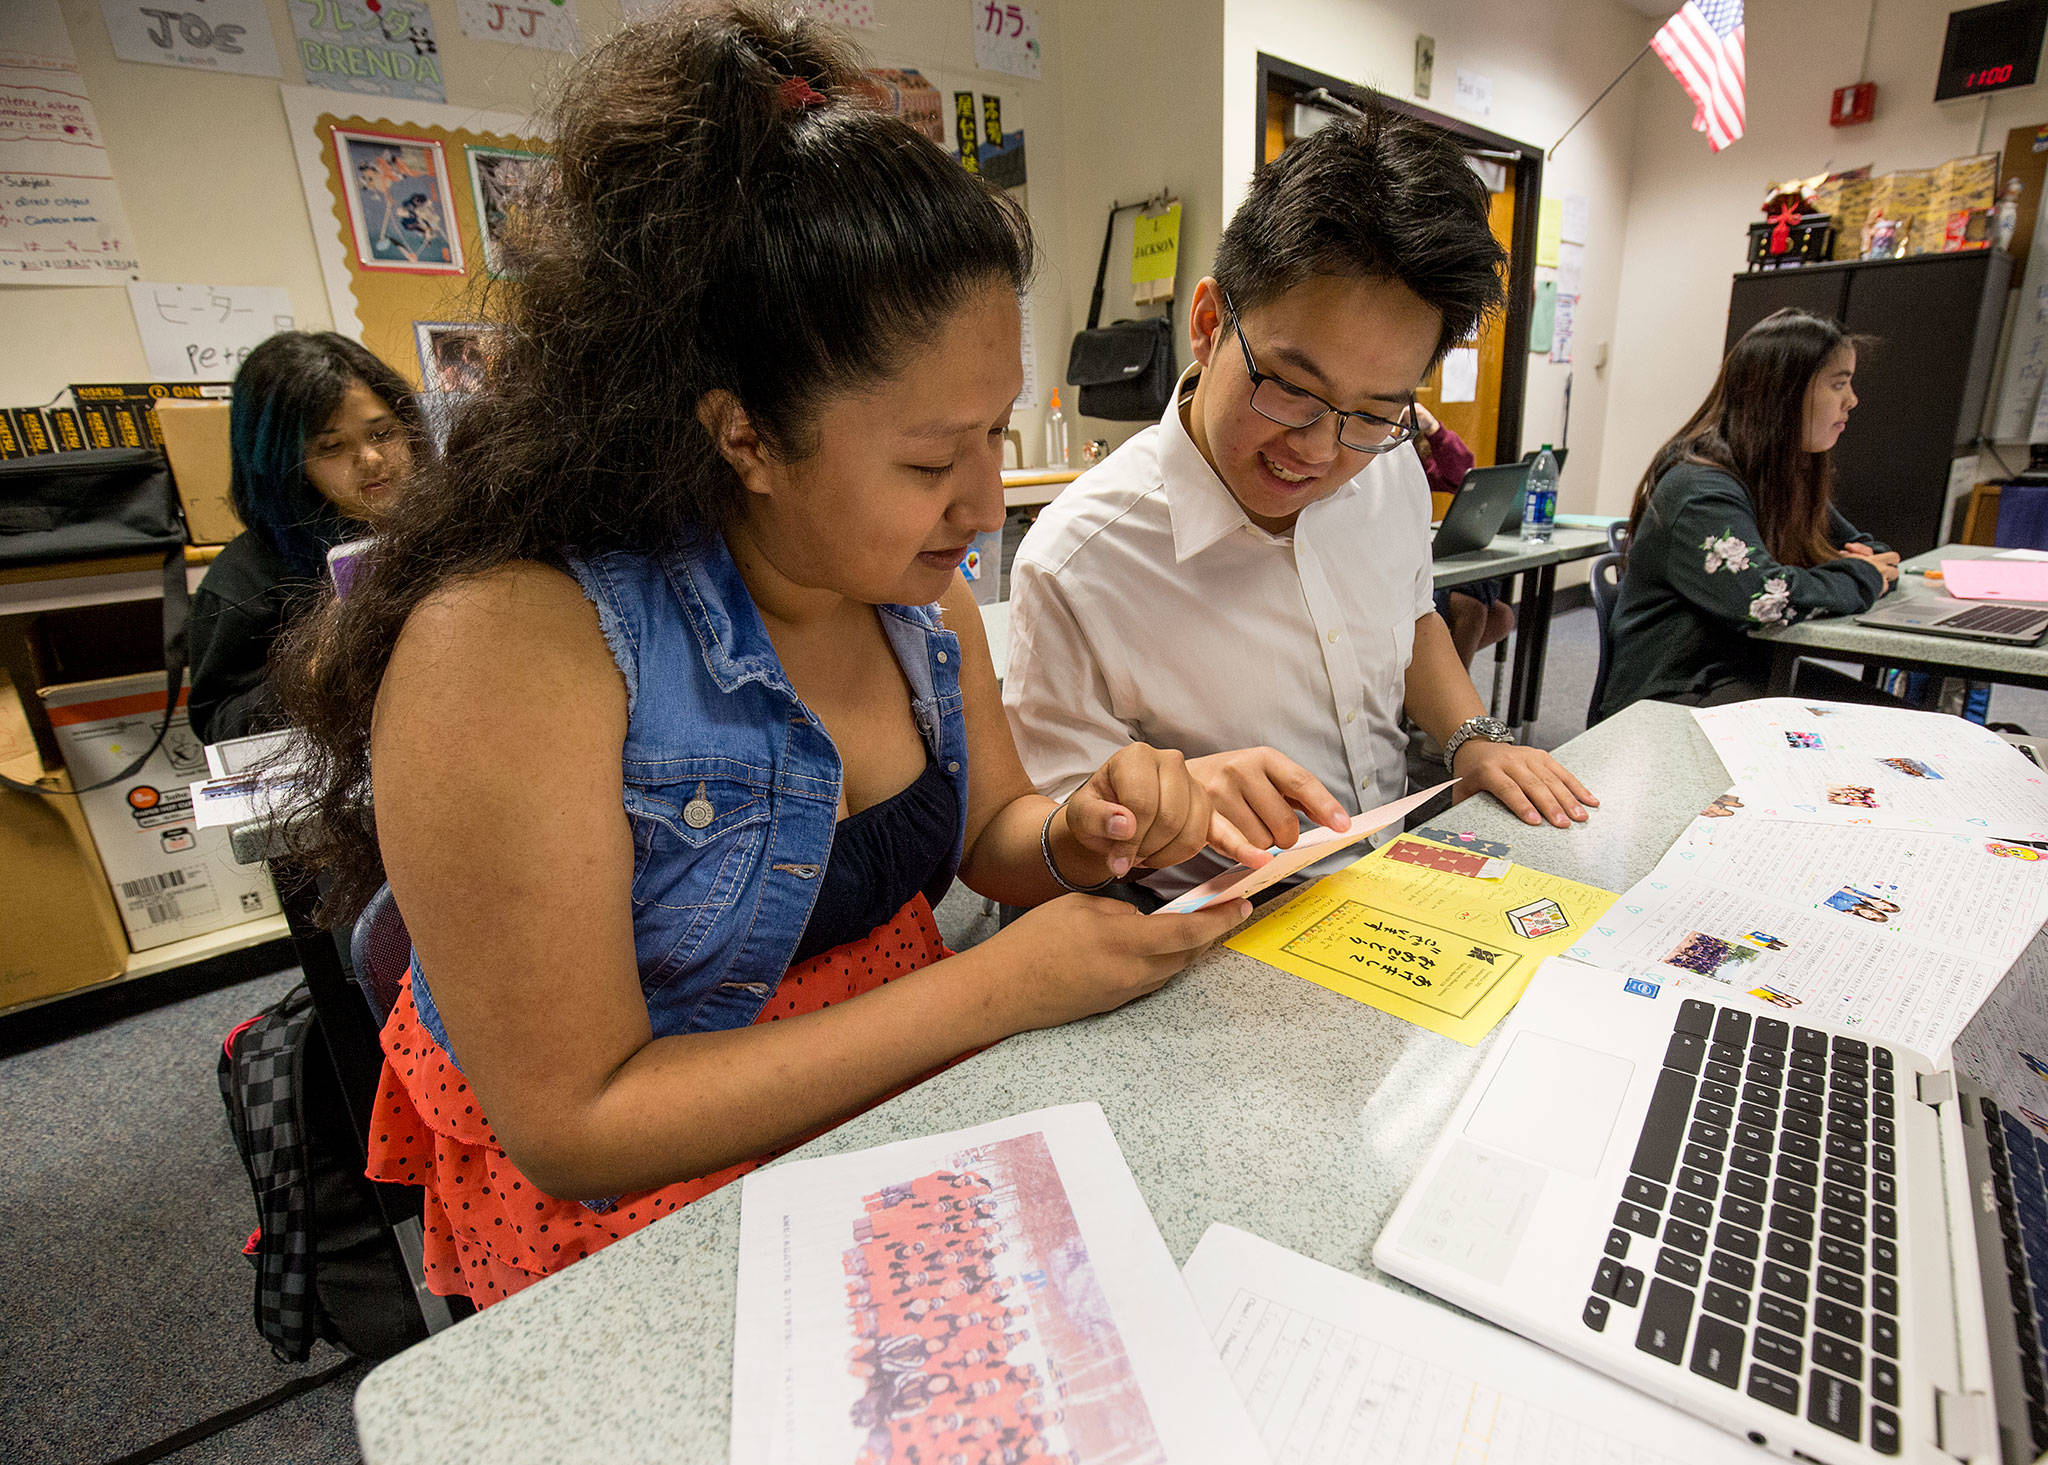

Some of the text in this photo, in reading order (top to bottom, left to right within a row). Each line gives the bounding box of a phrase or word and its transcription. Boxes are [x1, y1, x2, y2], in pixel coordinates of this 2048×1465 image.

[139, 7, 247, 54] JOE
[984, 1, 1023, 38] カラ
[302, 40, 441, 83] BRENDA
[1134, 236, 1175, 258] JACKSON
[1349, 936, 1437, 971] おめでとう
[1349, 954, 1433, 988] あけまして
[1789, 1162, 1802, 1171] y
